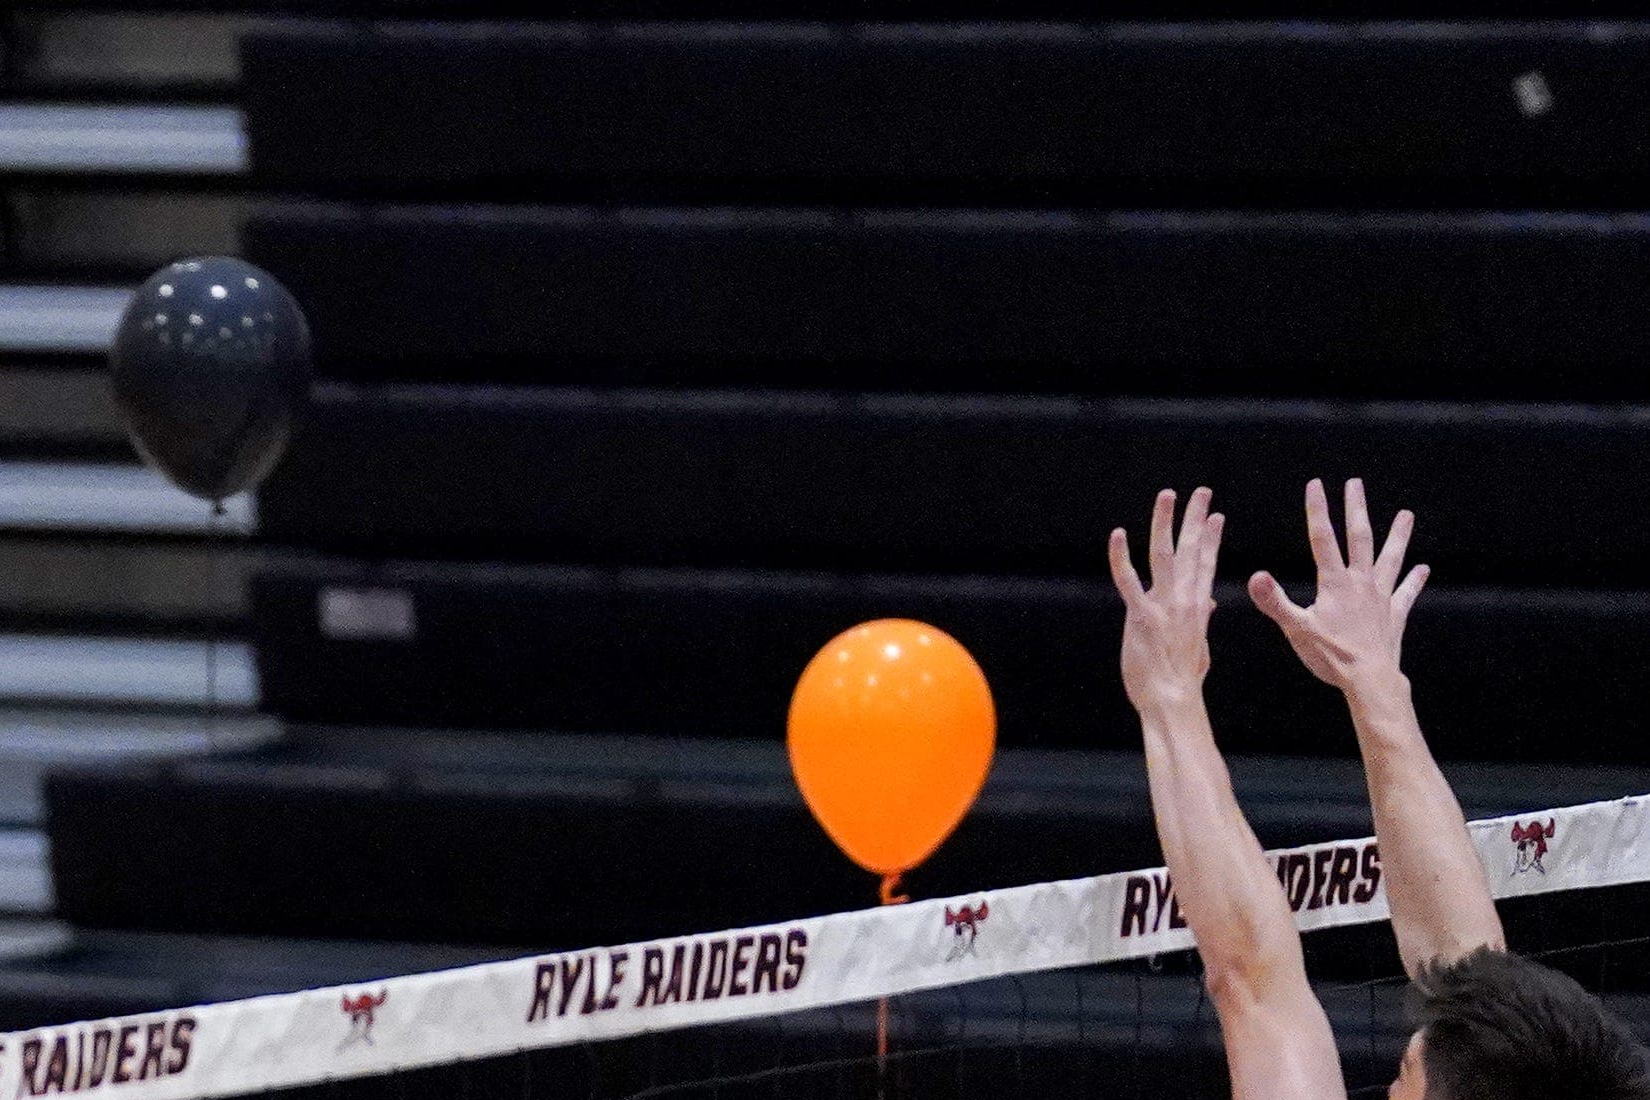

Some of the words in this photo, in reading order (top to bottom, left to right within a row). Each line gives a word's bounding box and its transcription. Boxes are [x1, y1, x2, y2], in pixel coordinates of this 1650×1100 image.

[1120, 873, 1188, 938] RYL
[527, 950, 630, 1023] RYLE
[635, 928, 810, 1009] RAIDERS
[18, 1017, 198, 1100] RAIDERS
